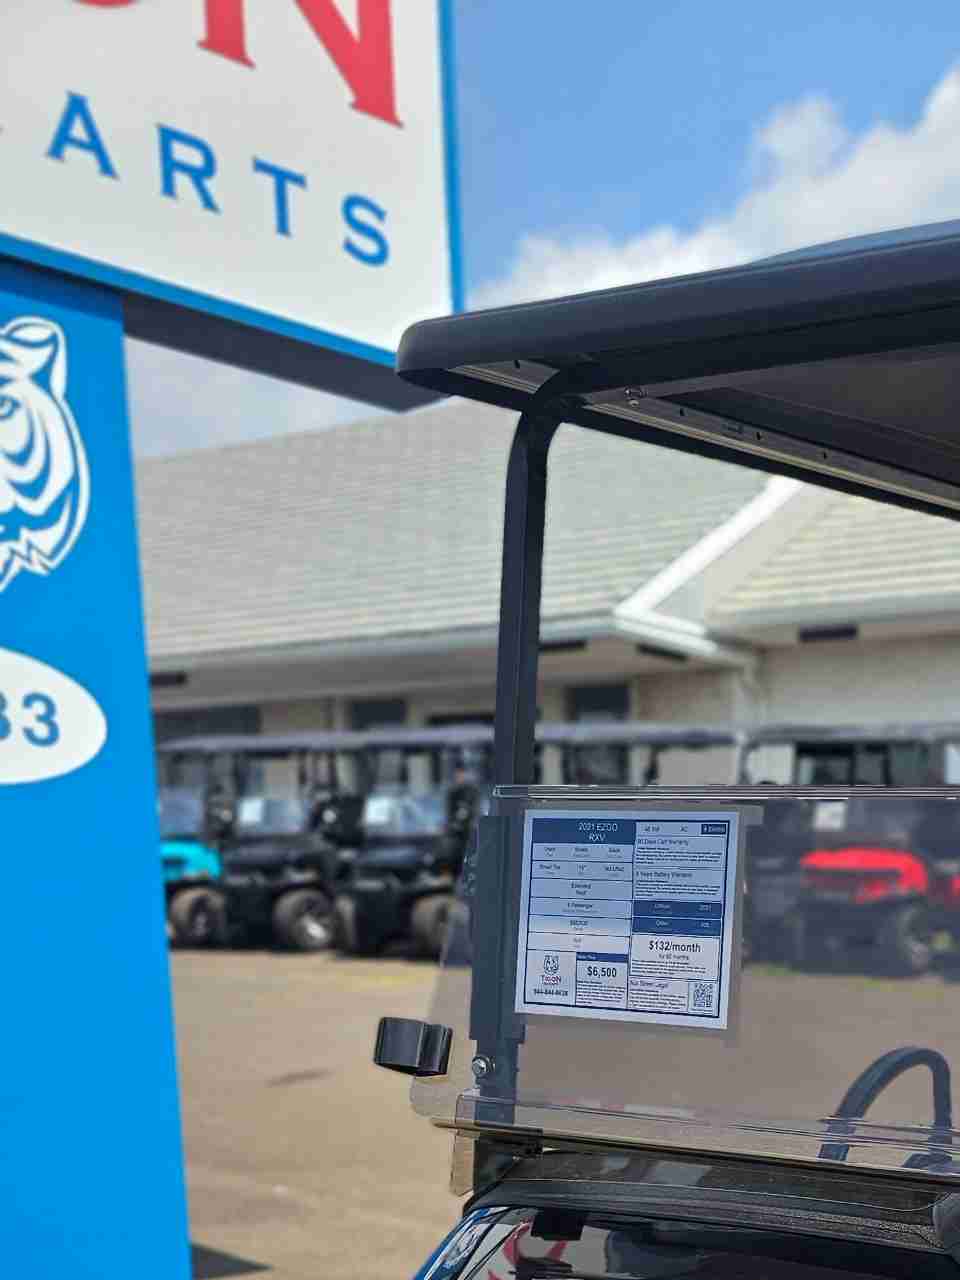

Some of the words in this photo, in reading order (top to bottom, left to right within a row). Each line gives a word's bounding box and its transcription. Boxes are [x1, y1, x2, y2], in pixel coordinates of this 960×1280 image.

[0, 90, 390, 267] ARTS
[648, 940, 702, 952] $132/month
[587, 966, 617, 977] $6,500
